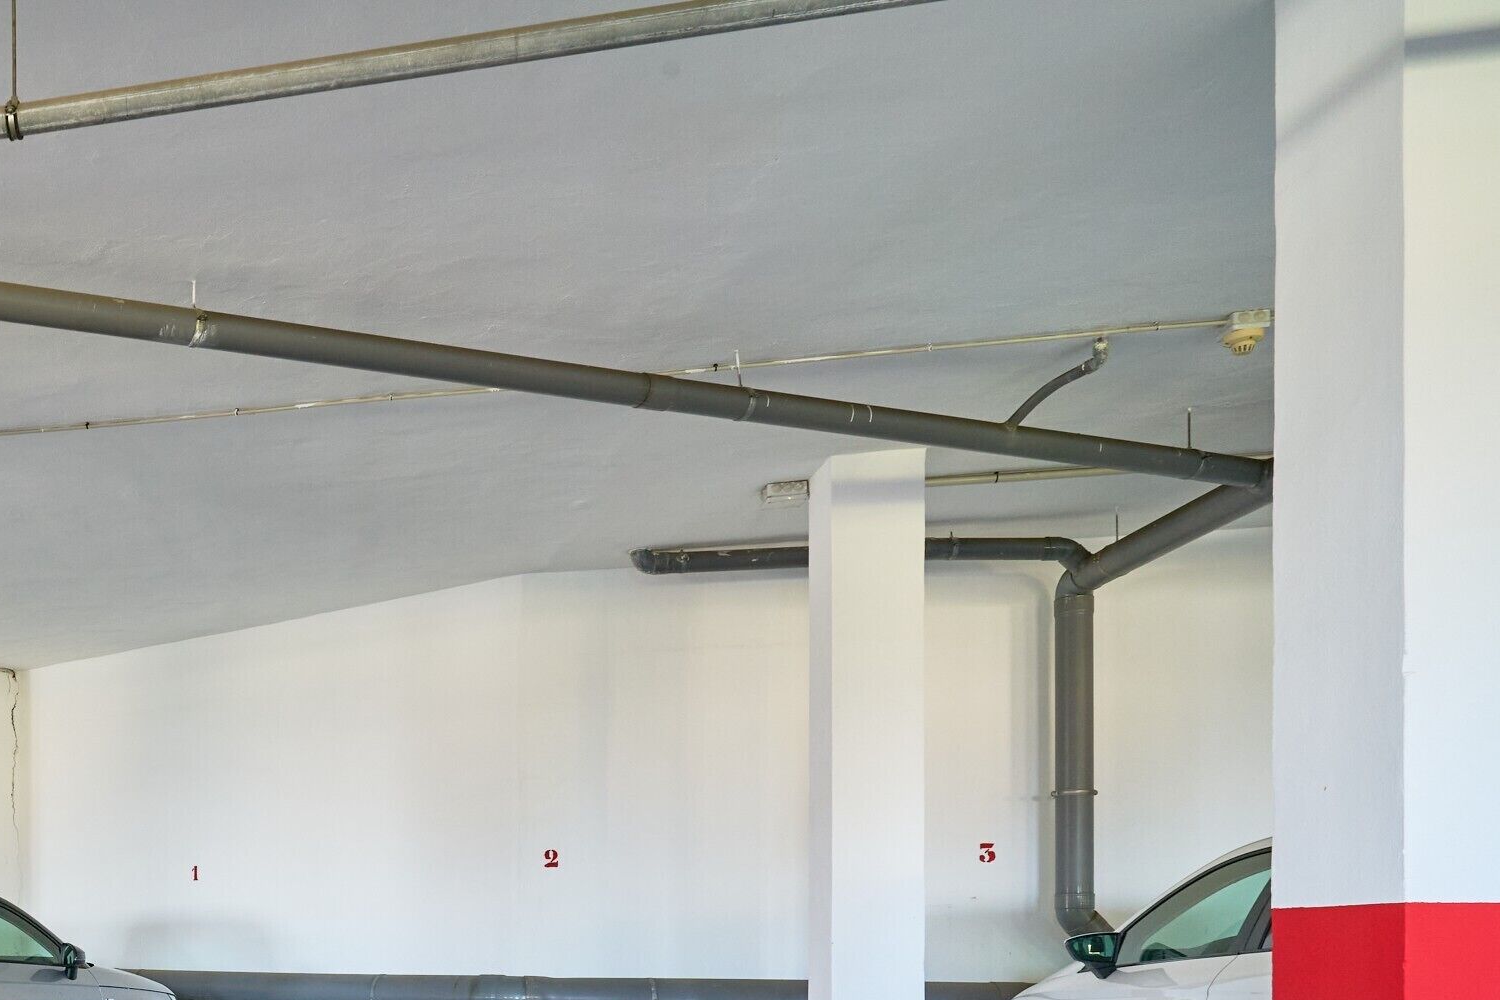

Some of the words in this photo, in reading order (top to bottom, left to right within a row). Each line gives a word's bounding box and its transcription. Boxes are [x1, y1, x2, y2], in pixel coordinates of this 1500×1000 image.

[544, 849, 558, 867] 2
[979, 842, 995, 862] 3
[191, 865, 198, 880] 1
